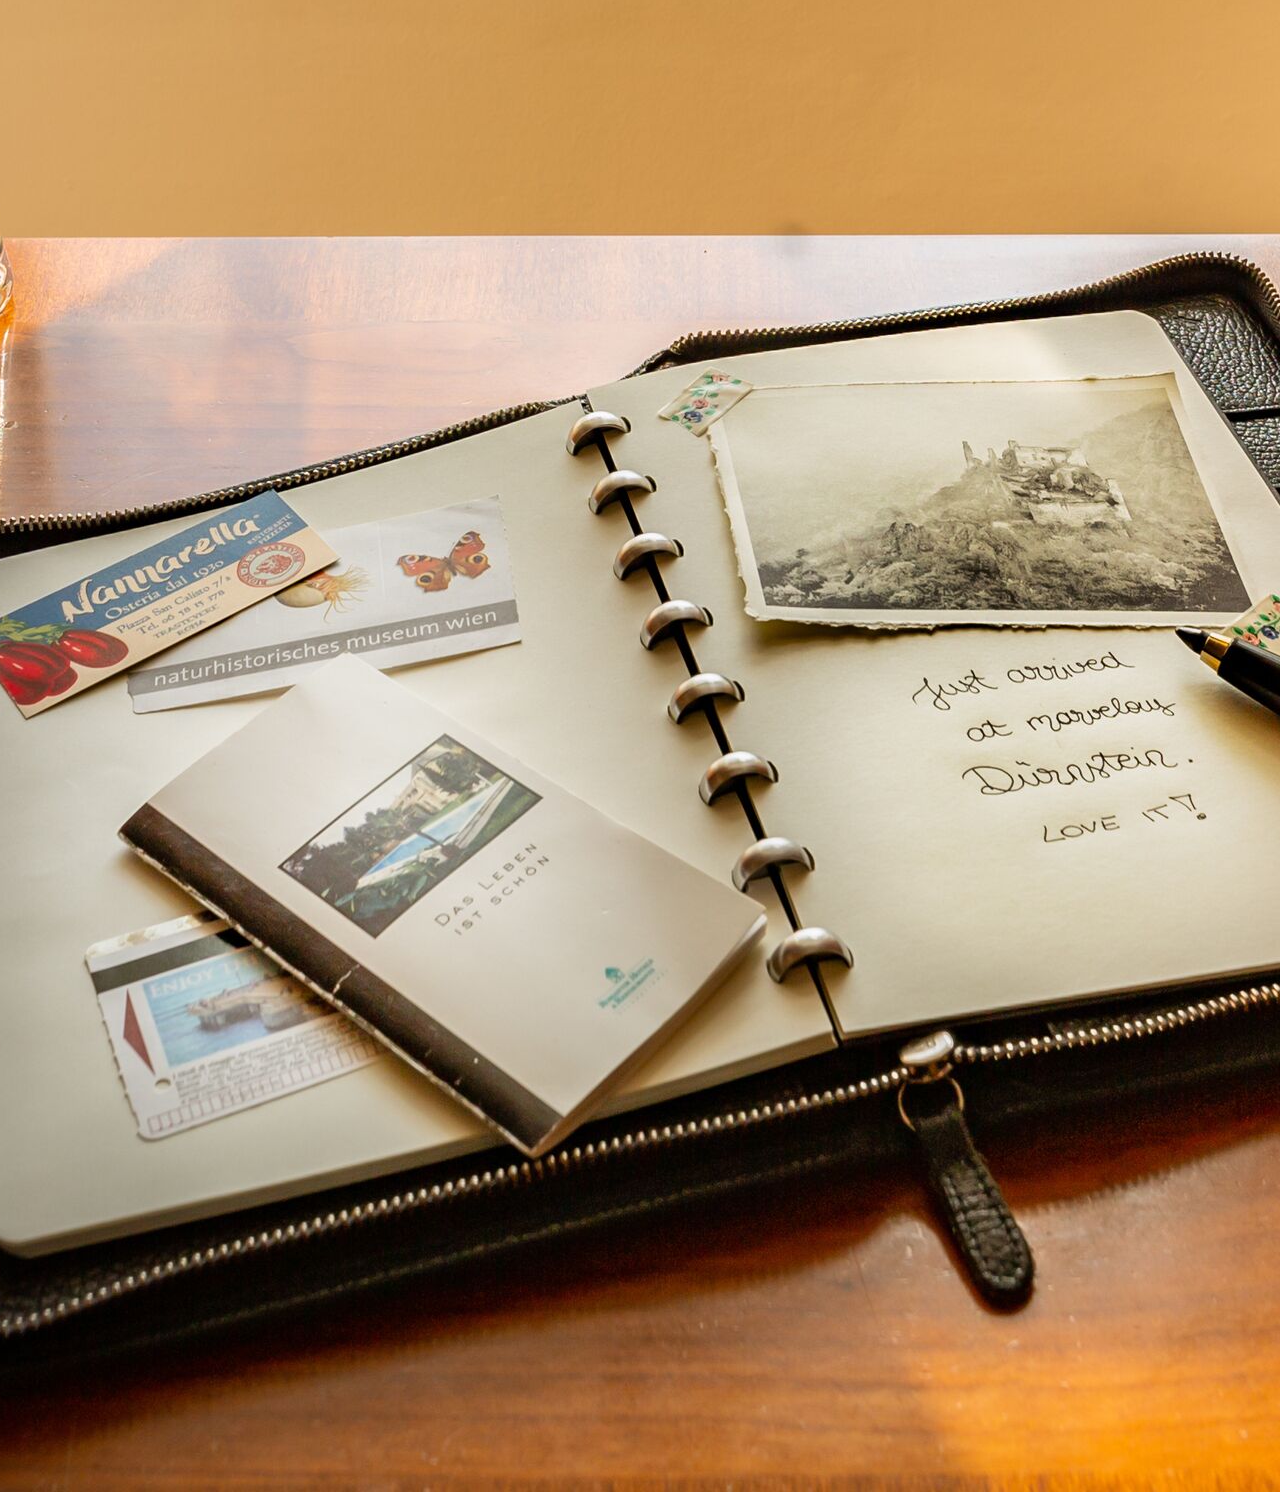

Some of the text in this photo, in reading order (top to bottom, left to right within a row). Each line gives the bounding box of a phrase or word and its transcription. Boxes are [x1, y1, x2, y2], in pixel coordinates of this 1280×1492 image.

[61, 518, 260, 623] Nannarella
[105, 560, 224, 619] Osteria dal 1930
[116, 615, 151, 634] Piazza
[152, 604, 173, 616] San
[175, 586, 210, 605] Calisto
[136, 622, 159, 635] Tel.
[162, 614, 175, 624] 06
[153, 604, 218, 638] TRASTEVERE
[177, 619, 206, 636] ROMA
[154, 609, 497, 687] naturhistorisches museum wien
[1007, 651, 1135, 684] arrived
[966, 719, 1013, 742] at
[1042, 815, 1120, 843] LOVE
[454, 855, 550, 936] IST SCHÖN
